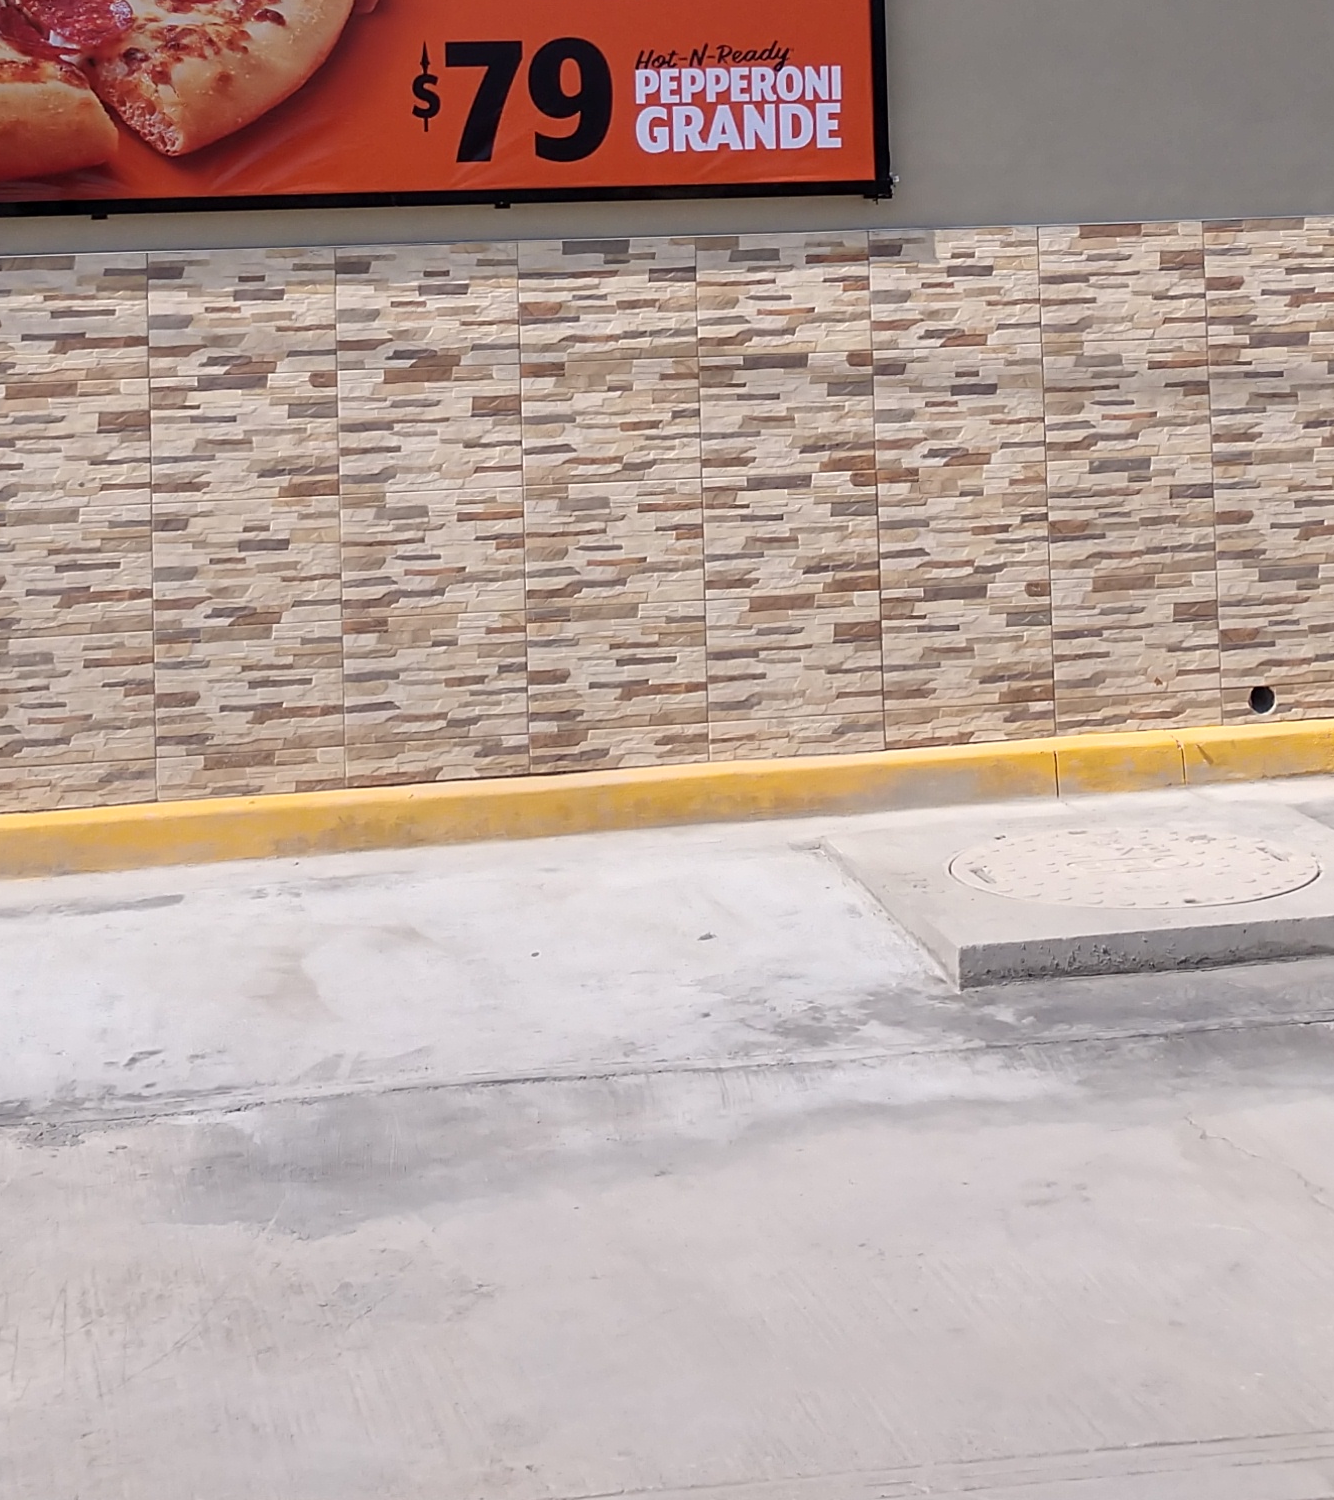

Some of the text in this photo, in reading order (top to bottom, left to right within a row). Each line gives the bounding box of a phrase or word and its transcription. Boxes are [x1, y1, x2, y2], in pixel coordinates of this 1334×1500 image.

[635, 40, 790, 71] Hot-N-Ready
[634, 65, 843, 104] PEPPERONI
[635, 103, 843, 154] GRANDE
